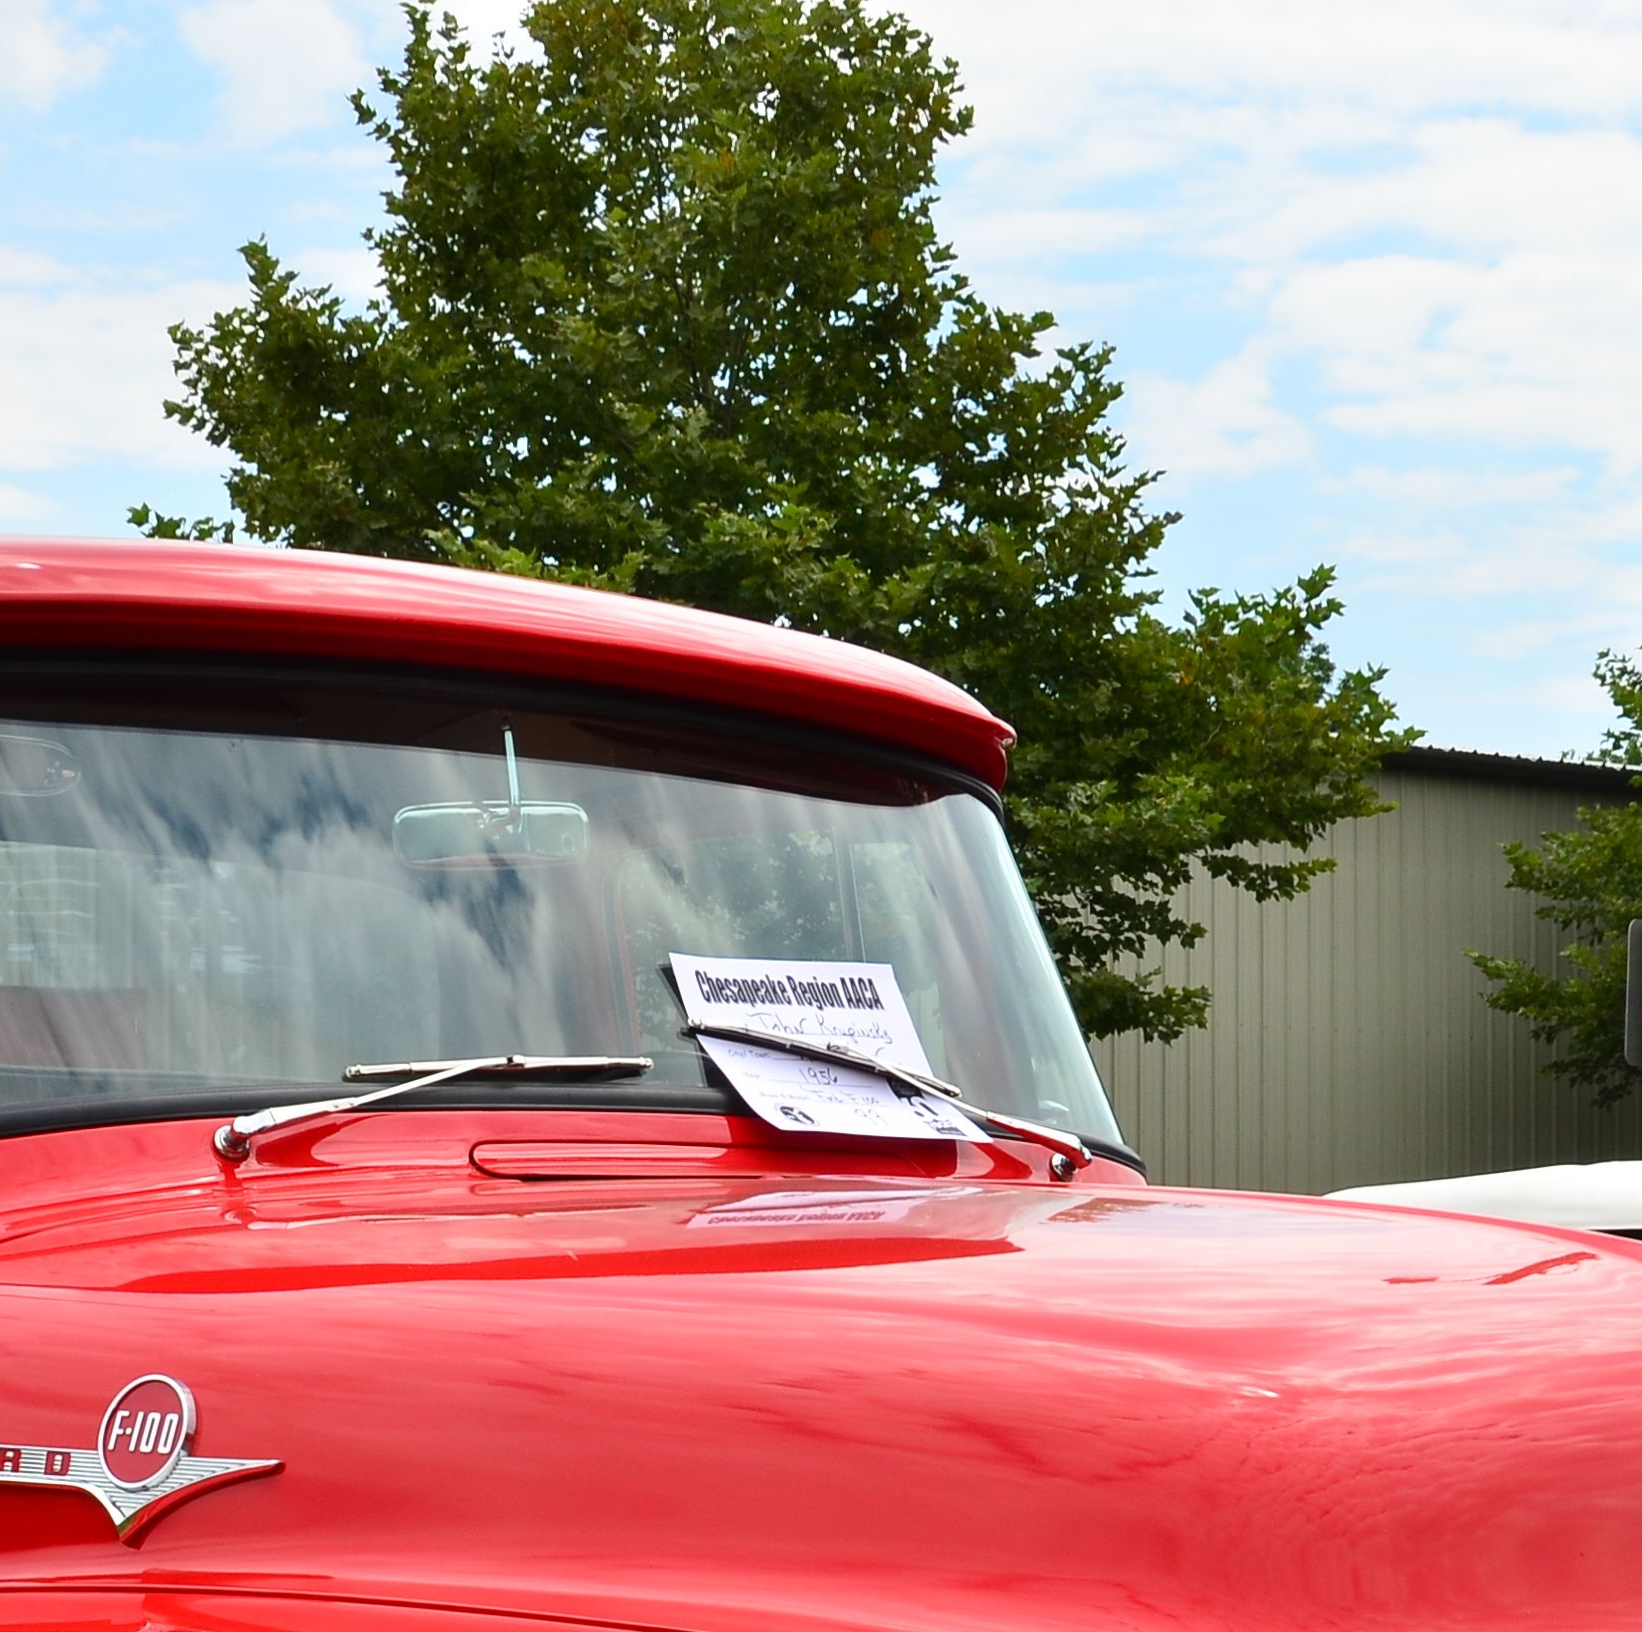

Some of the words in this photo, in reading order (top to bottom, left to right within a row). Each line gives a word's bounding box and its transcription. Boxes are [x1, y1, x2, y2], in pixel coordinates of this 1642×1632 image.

[694, 969, 790, 1008] Chesapeake
[785, 975, 845, 1011] Region
[839, 977, 885, 1010] AACA
[799, 1067, 839, 1086] 1956
